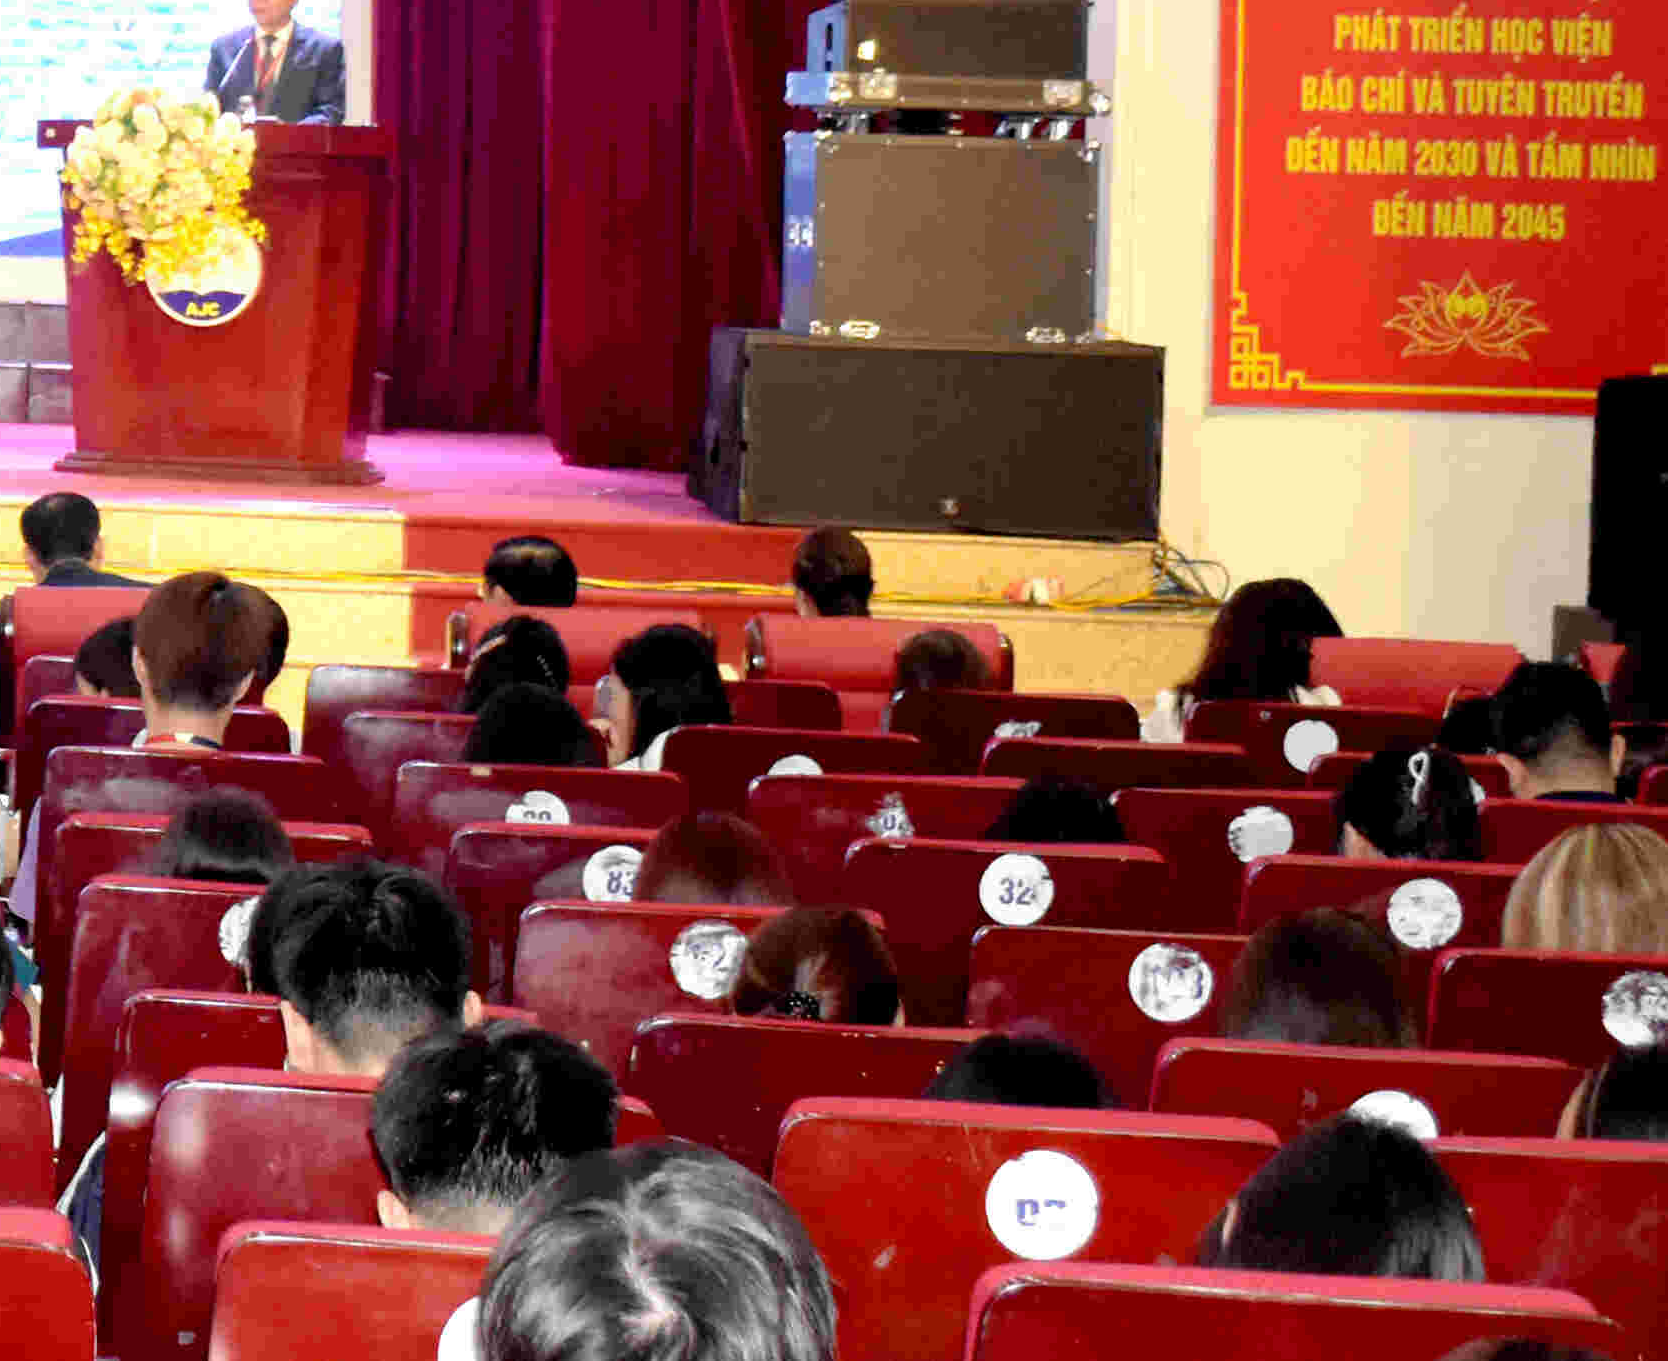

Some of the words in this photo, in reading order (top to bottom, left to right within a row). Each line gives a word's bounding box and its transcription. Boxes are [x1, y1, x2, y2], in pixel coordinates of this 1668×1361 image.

[1300, 68, 1354, 114] BÁO
[1414, 139, 1478, 178] 2030
[1501, 203, 1566, 242] 2045
[185, 301, 221, 318] AJC
